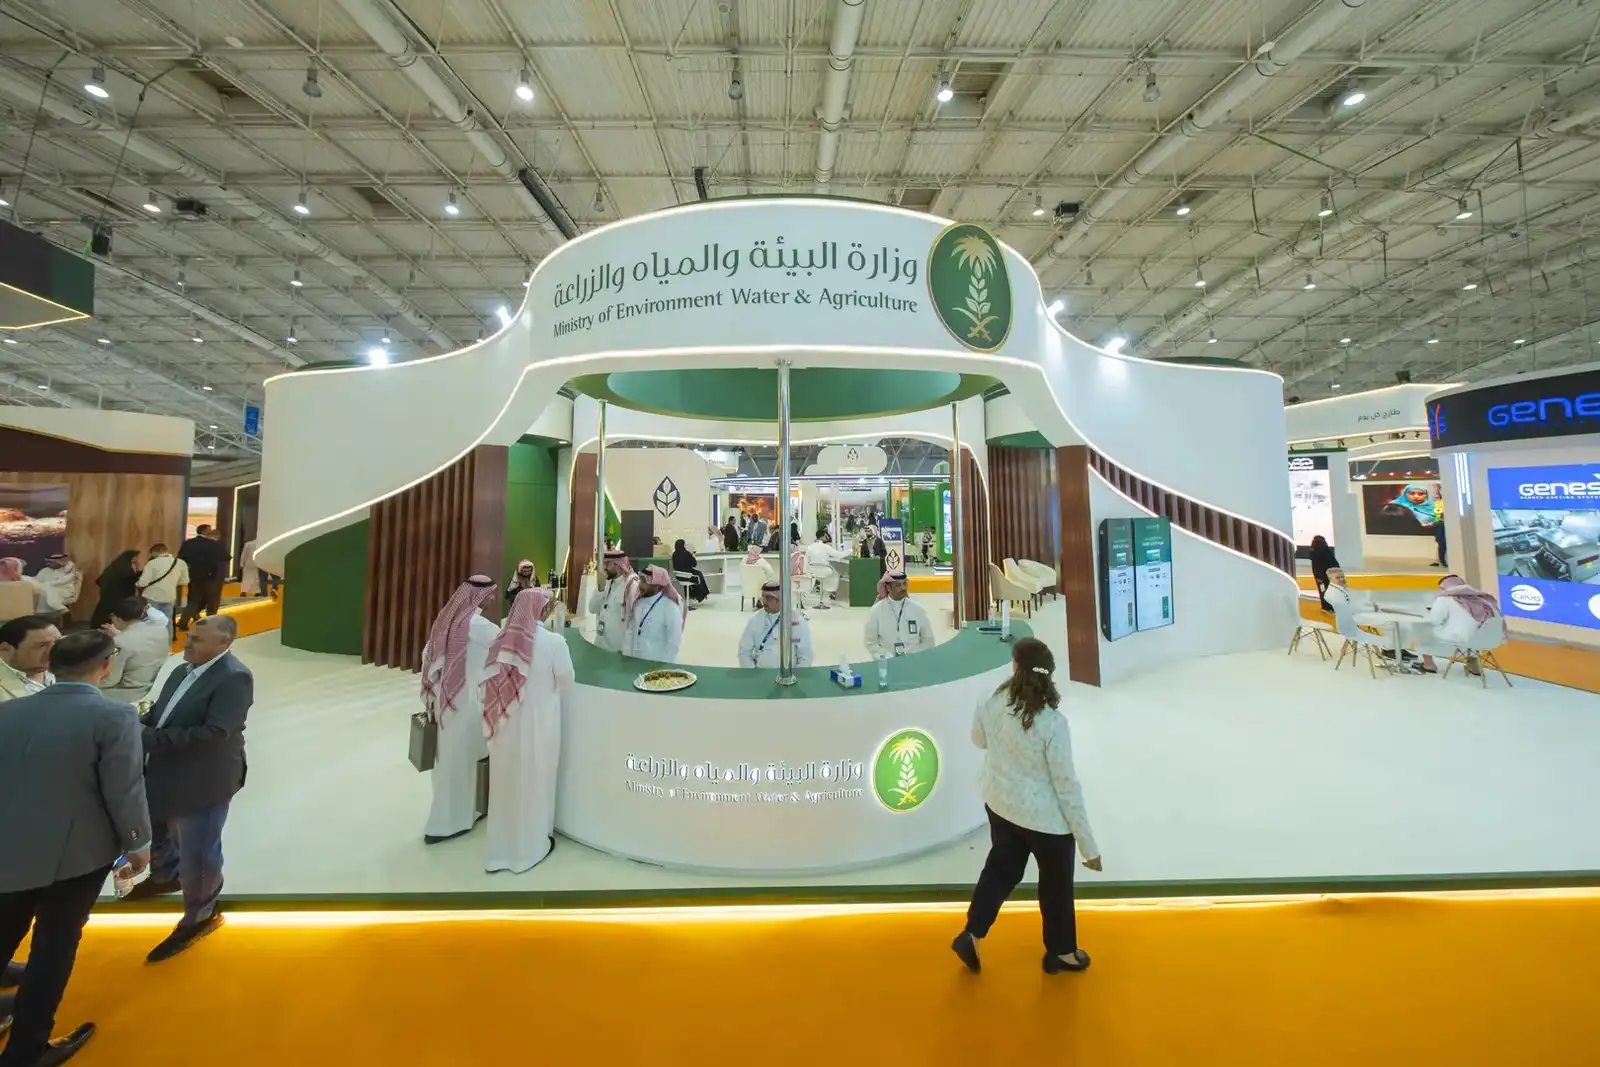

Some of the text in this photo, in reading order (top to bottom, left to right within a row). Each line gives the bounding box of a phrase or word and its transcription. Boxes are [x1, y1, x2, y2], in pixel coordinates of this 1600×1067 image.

[554, 235, 917, 309] وزارة البيئة والمياه والزراعة
[553, 287, 918, 339] Ministry of Environment Water & Agriculture
[625, 751, 863, 786] وزارة البيئة والمياه والزراعة
[624, 780, 664, 798] Ministry
[682, 787, 751, 803] Environment
[755, 791, 788, 803] Water
[790, 791, 800, 803] &
[804, 787, 863, 804] Agriculture
